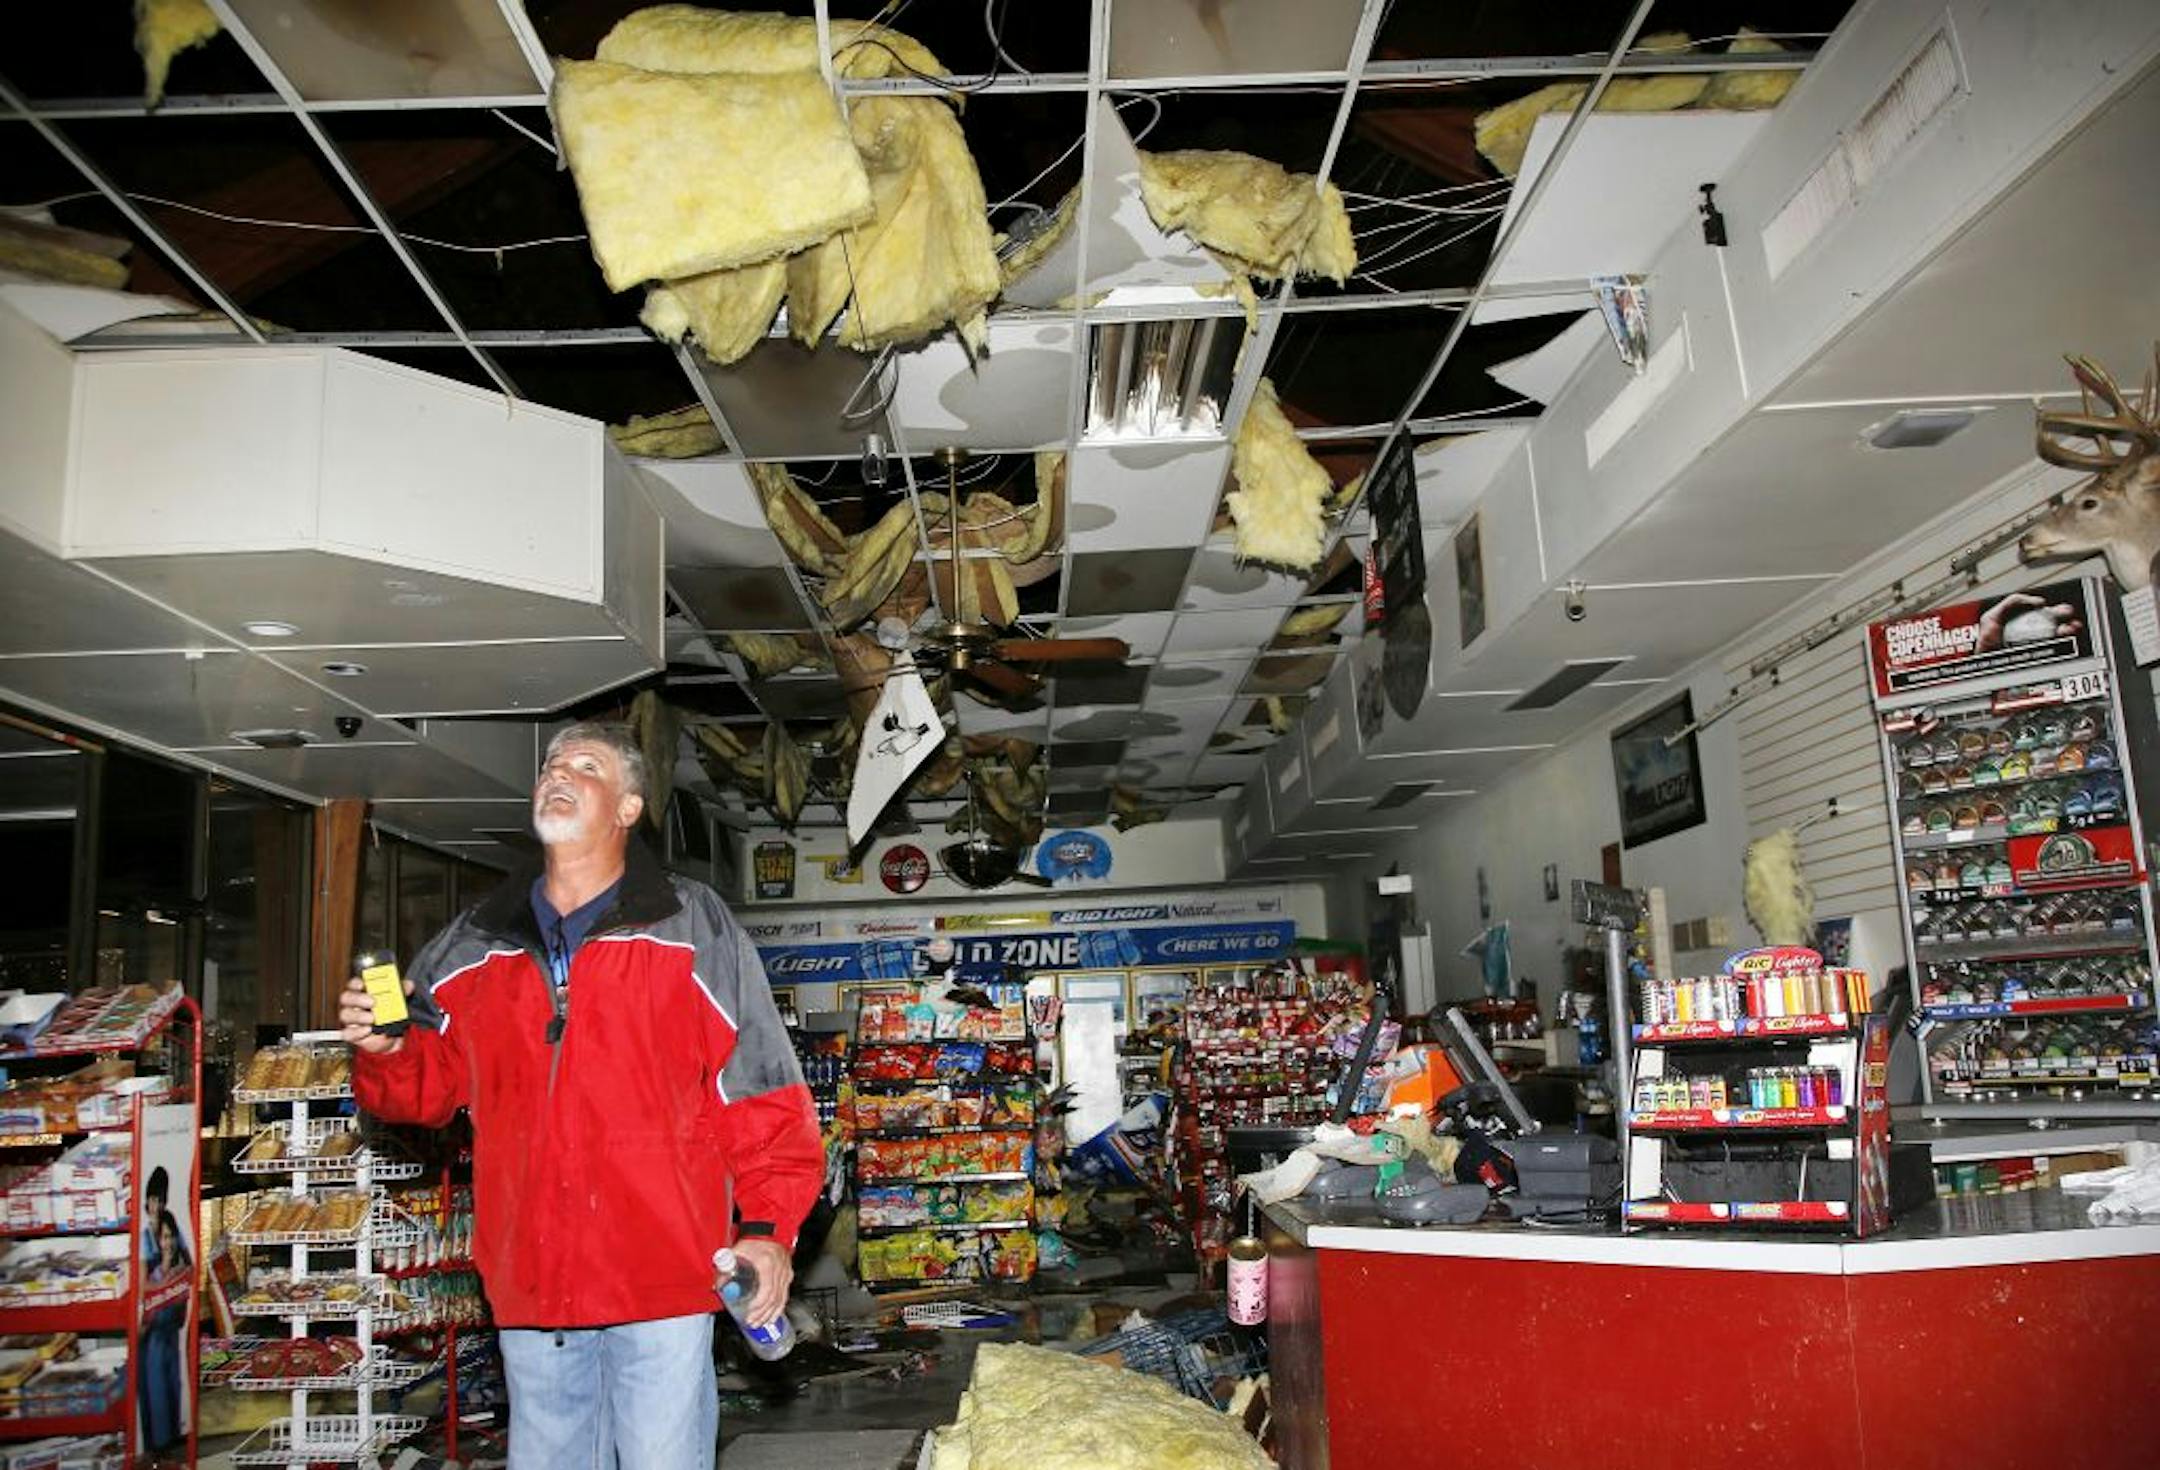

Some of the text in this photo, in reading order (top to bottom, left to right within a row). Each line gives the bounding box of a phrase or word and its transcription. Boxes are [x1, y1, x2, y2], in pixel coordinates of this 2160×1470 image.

[1886, 616, 1942, 642] CHOOSE
[1887, 624, 1981, 658] COPENHAGEN
[2068, 675, 2102, 698] 3.04
[1060, 906, 1159, 924] BUD LIGHT
[1173, 935, 1280, 953] HERE WE GO
[776, 955, 852, 974] LIGHT
[912, 938, 1079, 972] CLD ZONE
[1743, 959, 1770, 969] BIC
